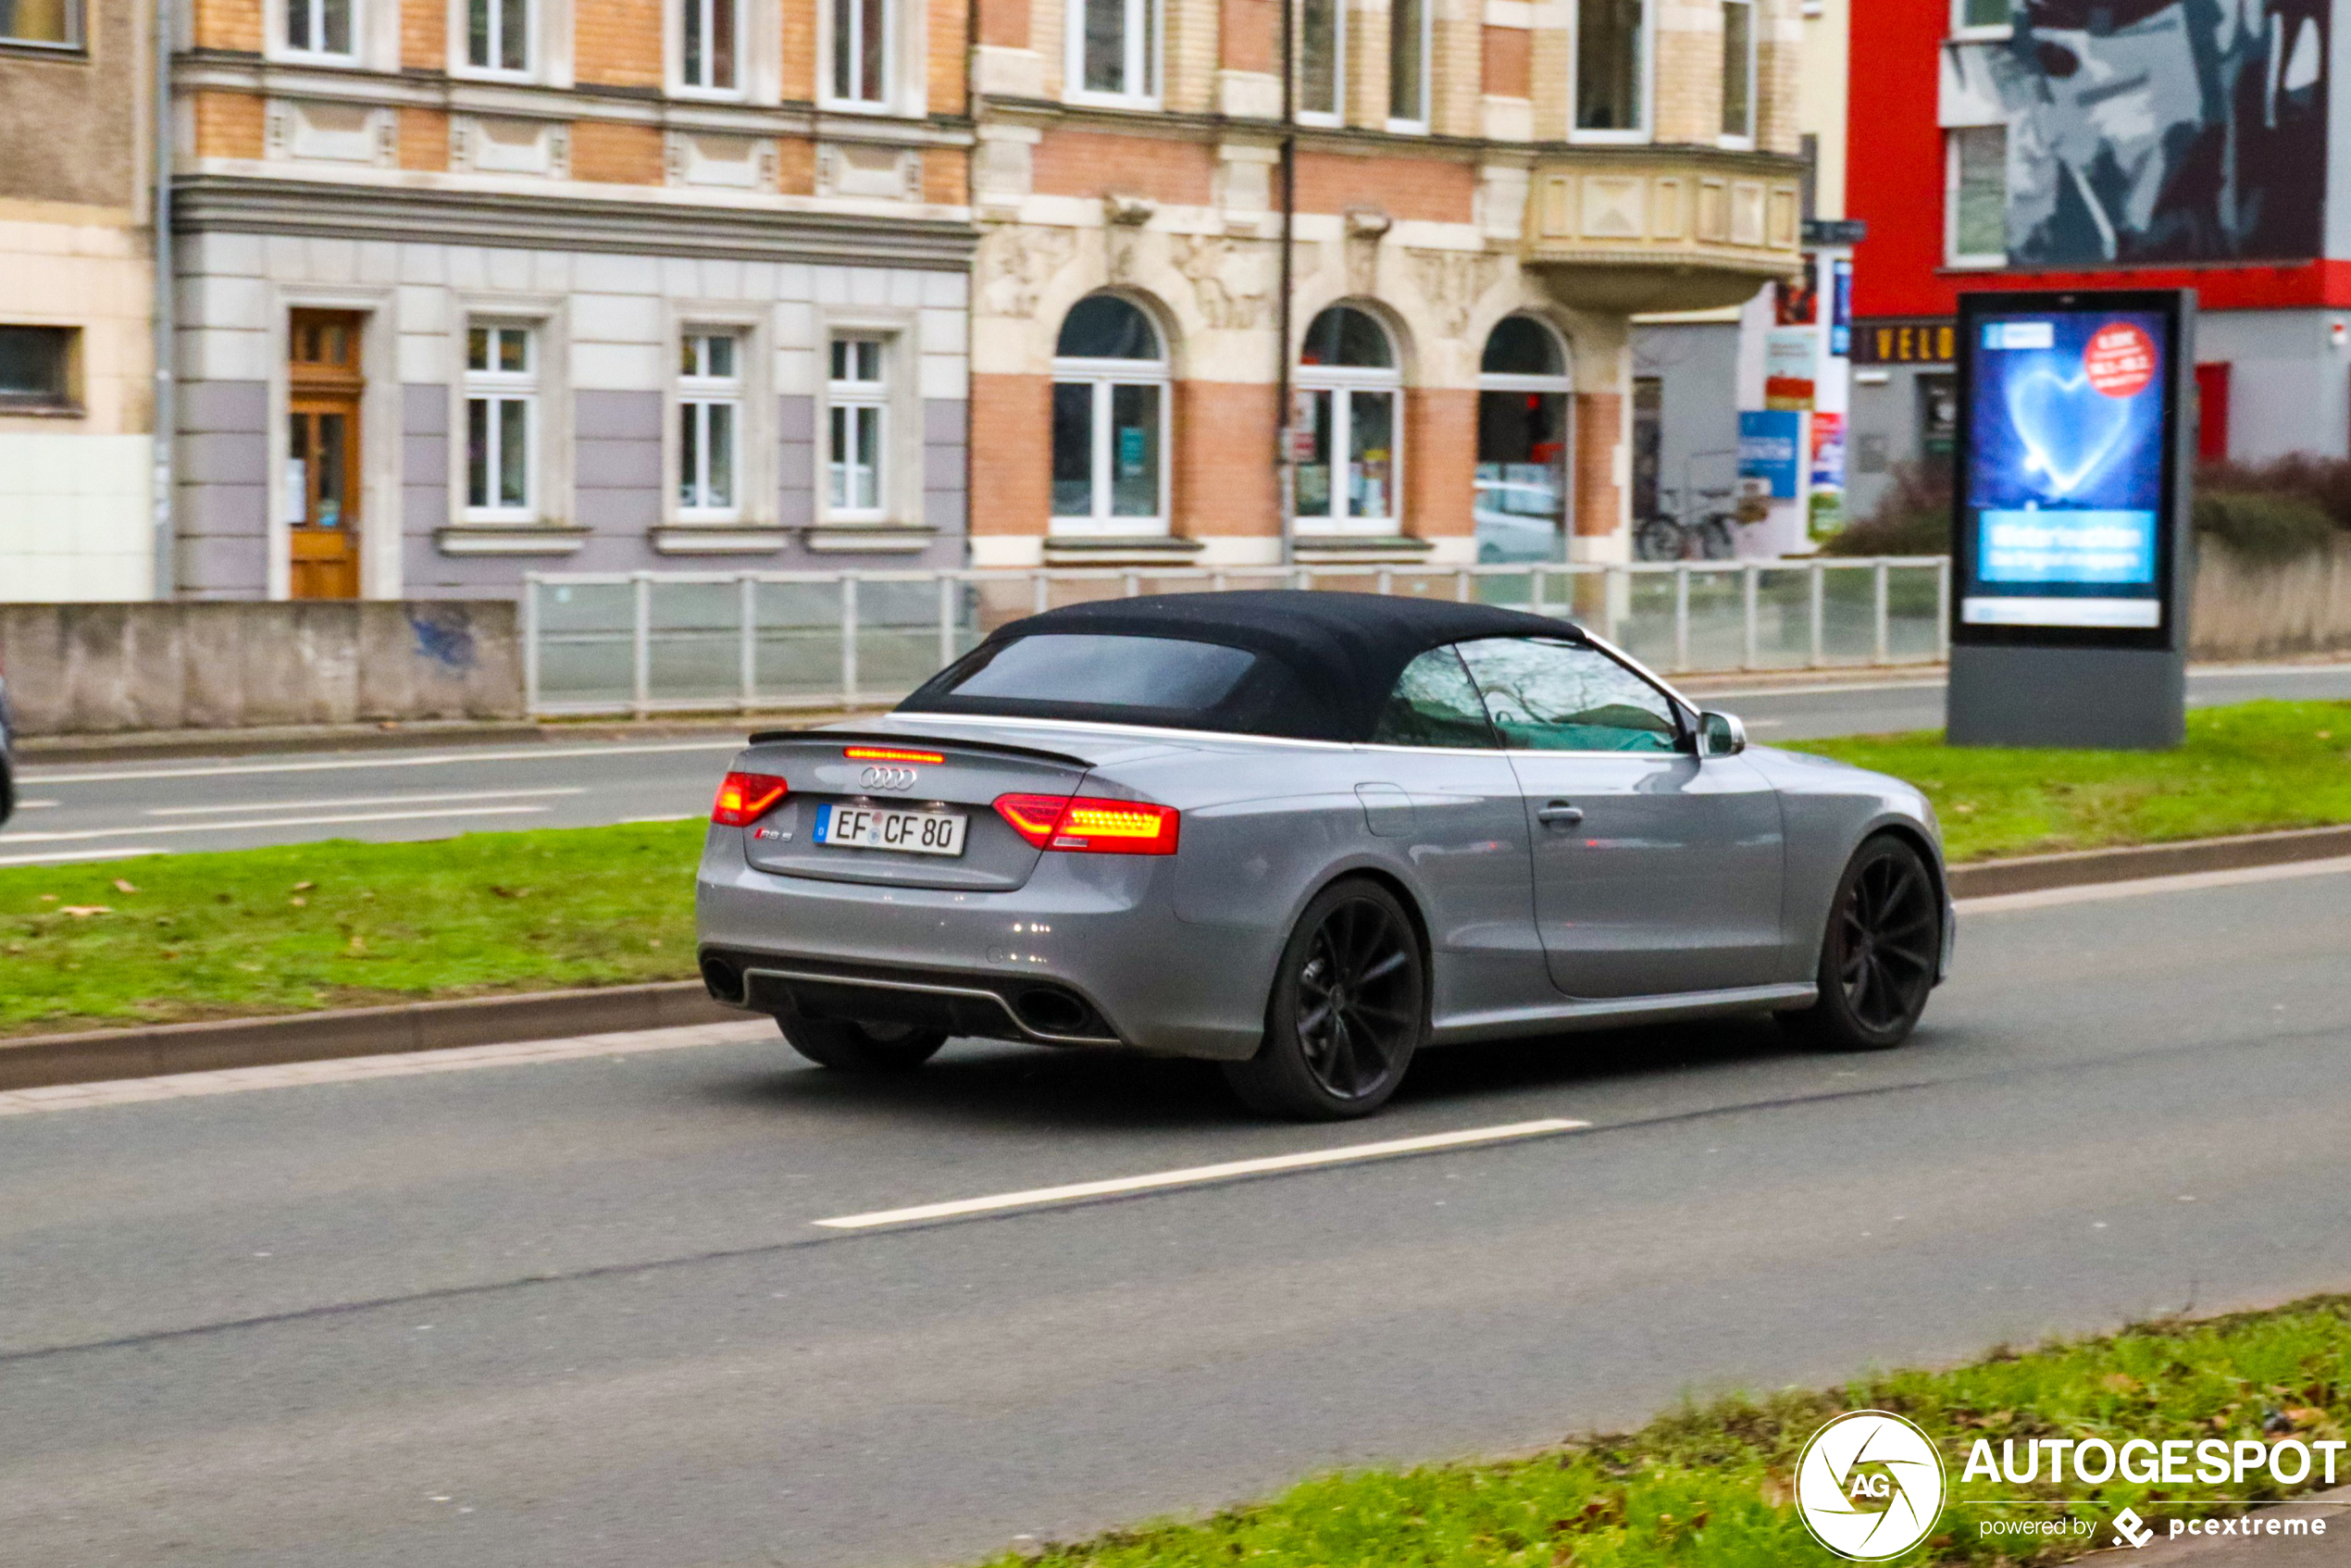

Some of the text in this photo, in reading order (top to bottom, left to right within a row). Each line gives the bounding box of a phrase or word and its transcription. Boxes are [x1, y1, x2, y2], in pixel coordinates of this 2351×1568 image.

[837, 810, 953, 849] EF CF 80
